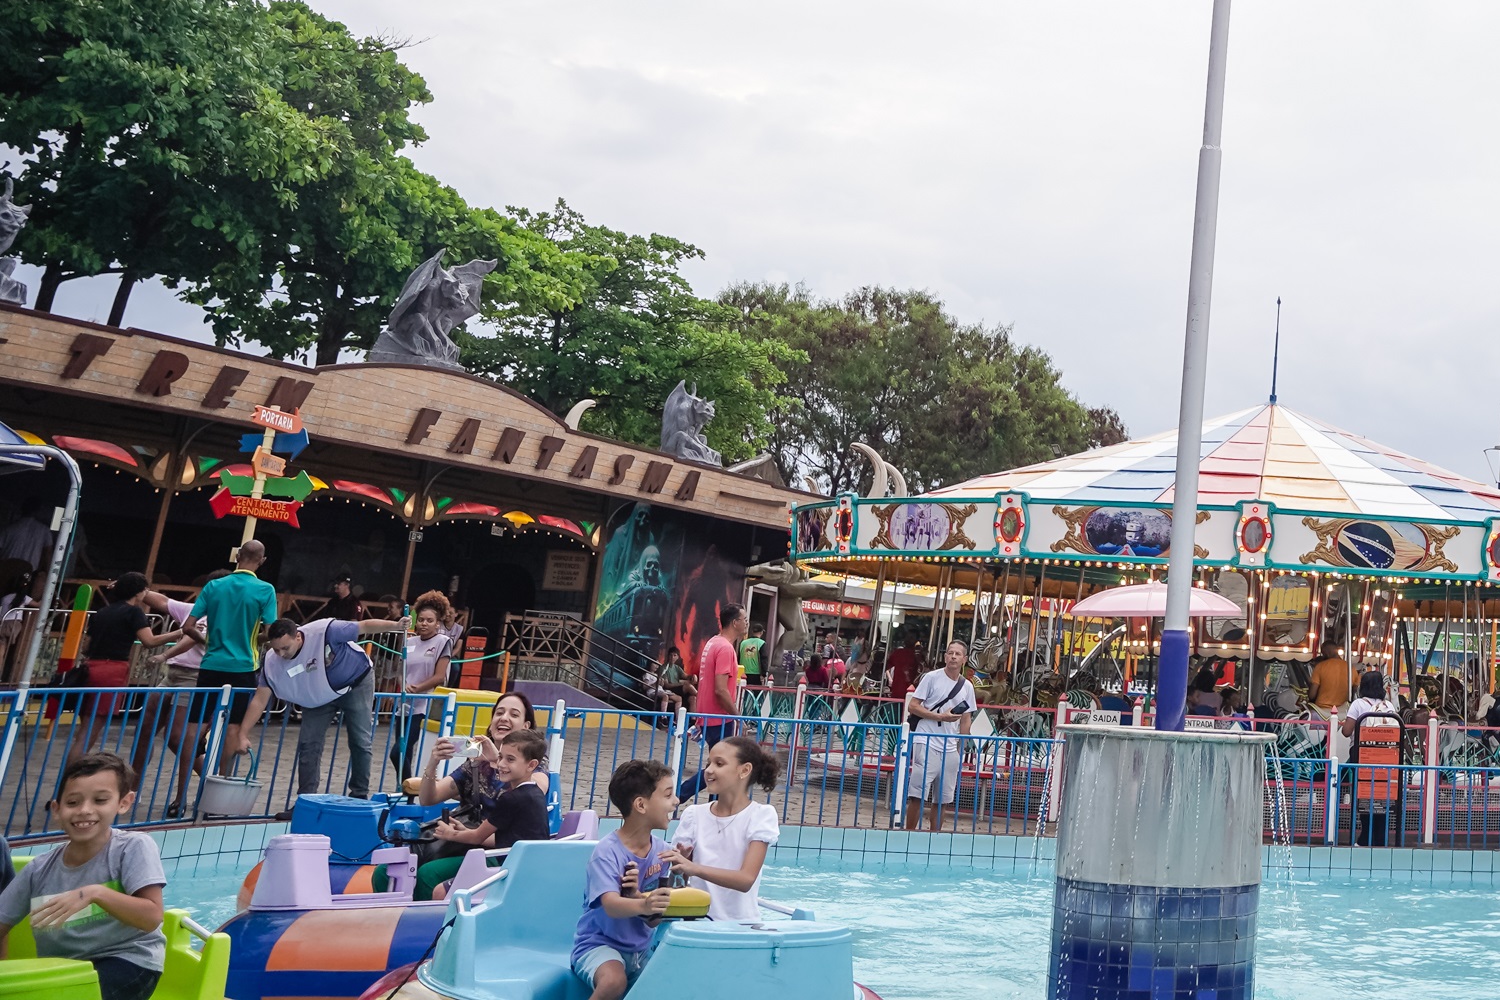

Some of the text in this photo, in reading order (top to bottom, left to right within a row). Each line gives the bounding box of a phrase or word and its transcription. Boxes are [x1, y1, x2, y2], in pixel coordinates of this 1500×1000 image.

[61, 332, 702, 501] TREM FANTASMA
[260, 409, 294, 431] PORTARIA
[236, 498, 287, 511] CENTRAL DE
[230, 505, 290, 520] ATENDIMENTO
[1184, 719, 1213, 728] ENTRADA
